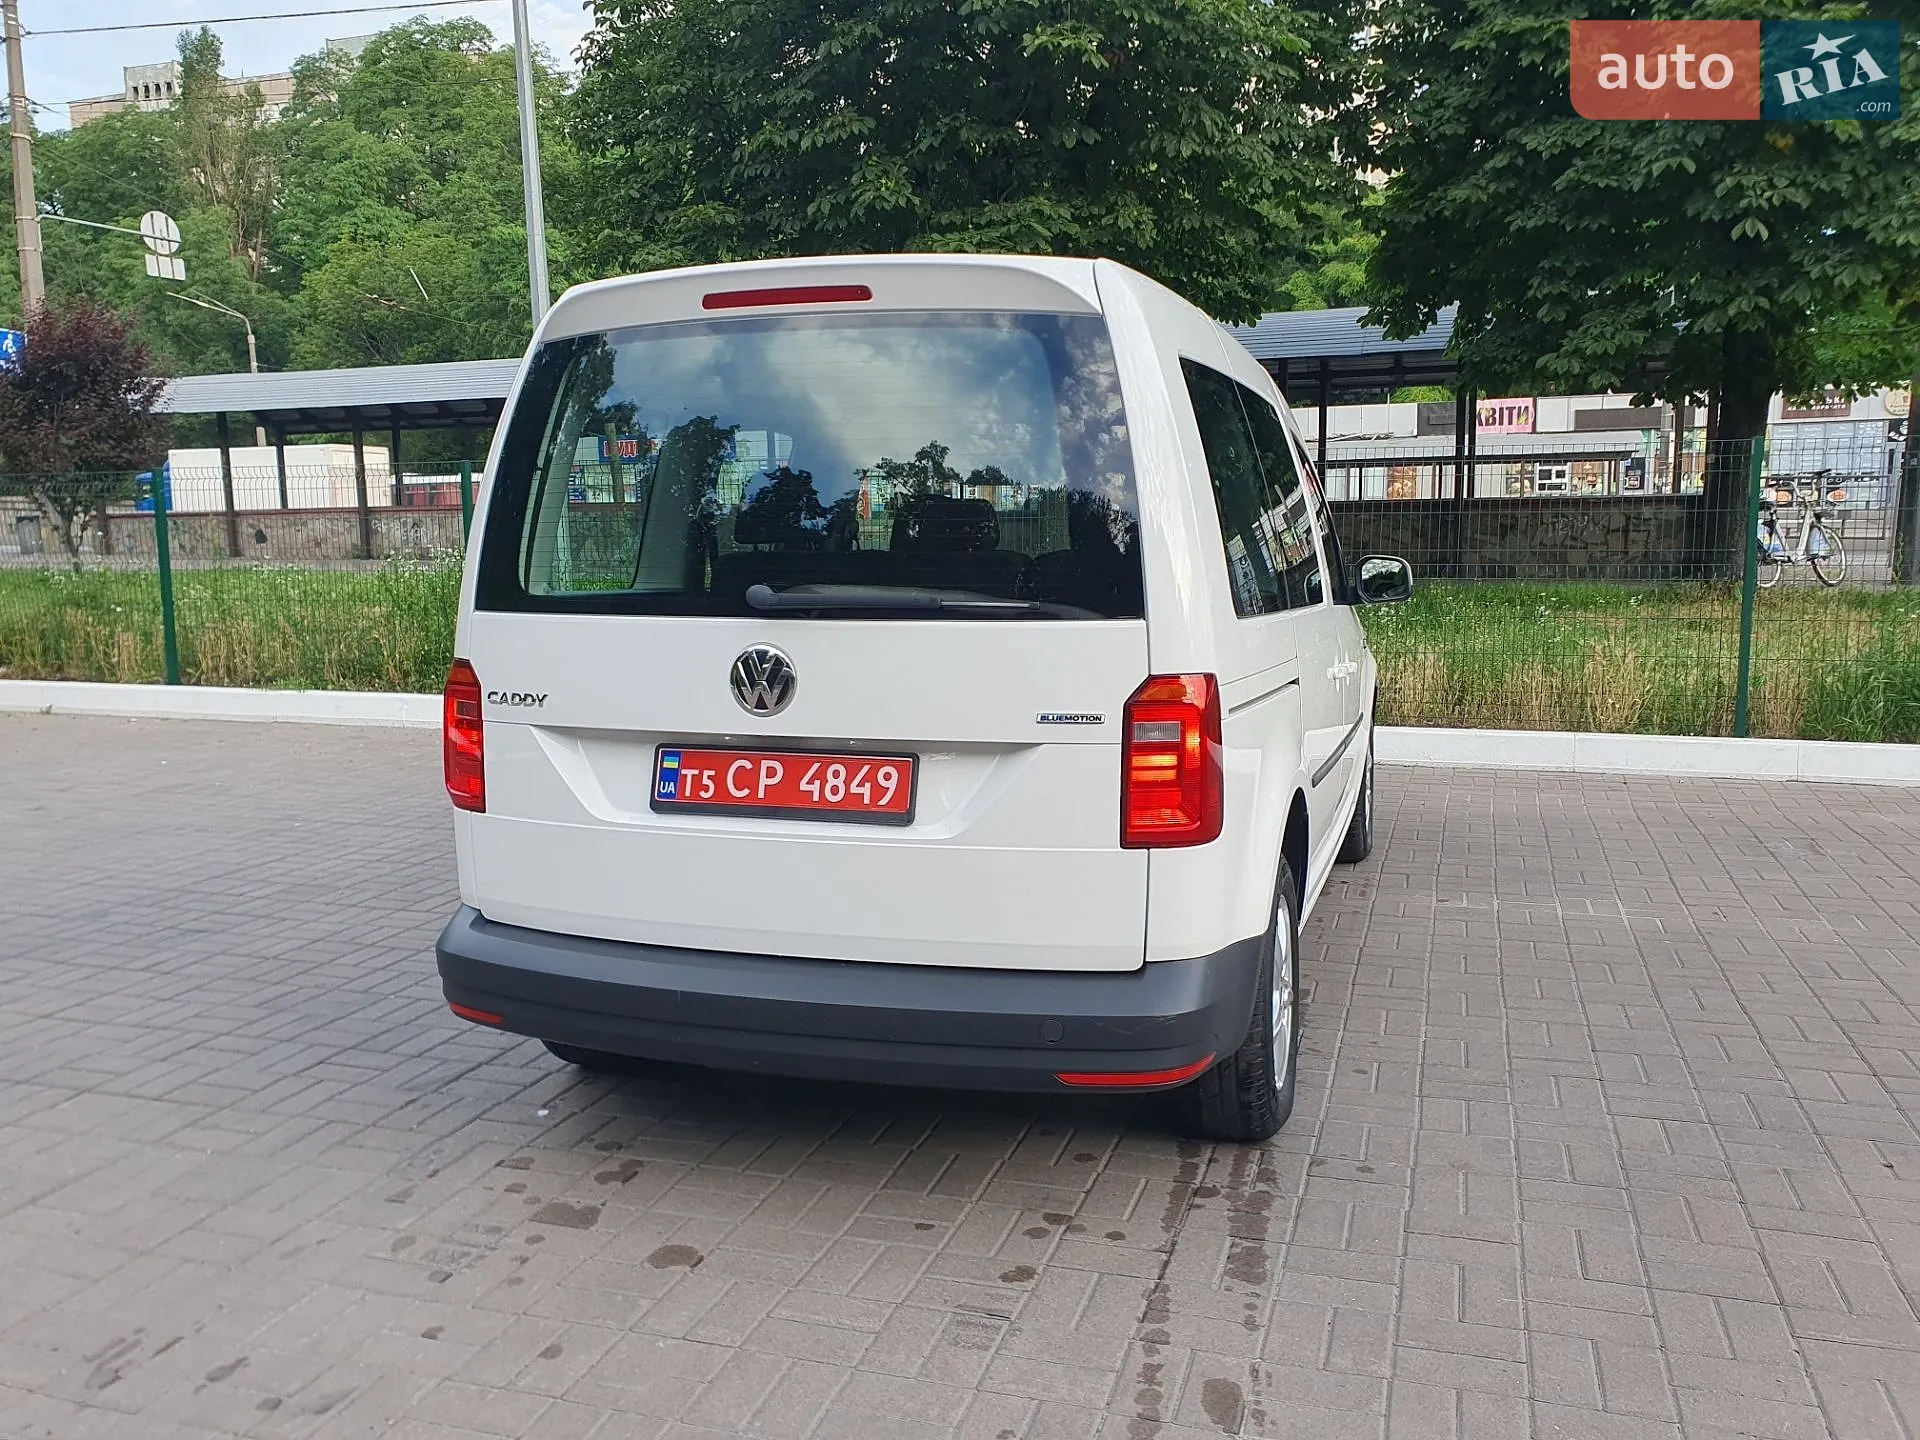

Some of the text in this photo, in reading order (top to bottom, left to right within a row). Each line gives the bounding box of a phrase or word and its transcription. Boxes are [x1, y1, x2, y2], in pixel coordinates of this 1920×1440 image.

[487, 691, 549, 708] CADDY
[1039, 714, 1103, 722] BLUEMOTION
[660, 780, 676, 794] UA
[681, 758, 899, 806] T5 CP 4849
